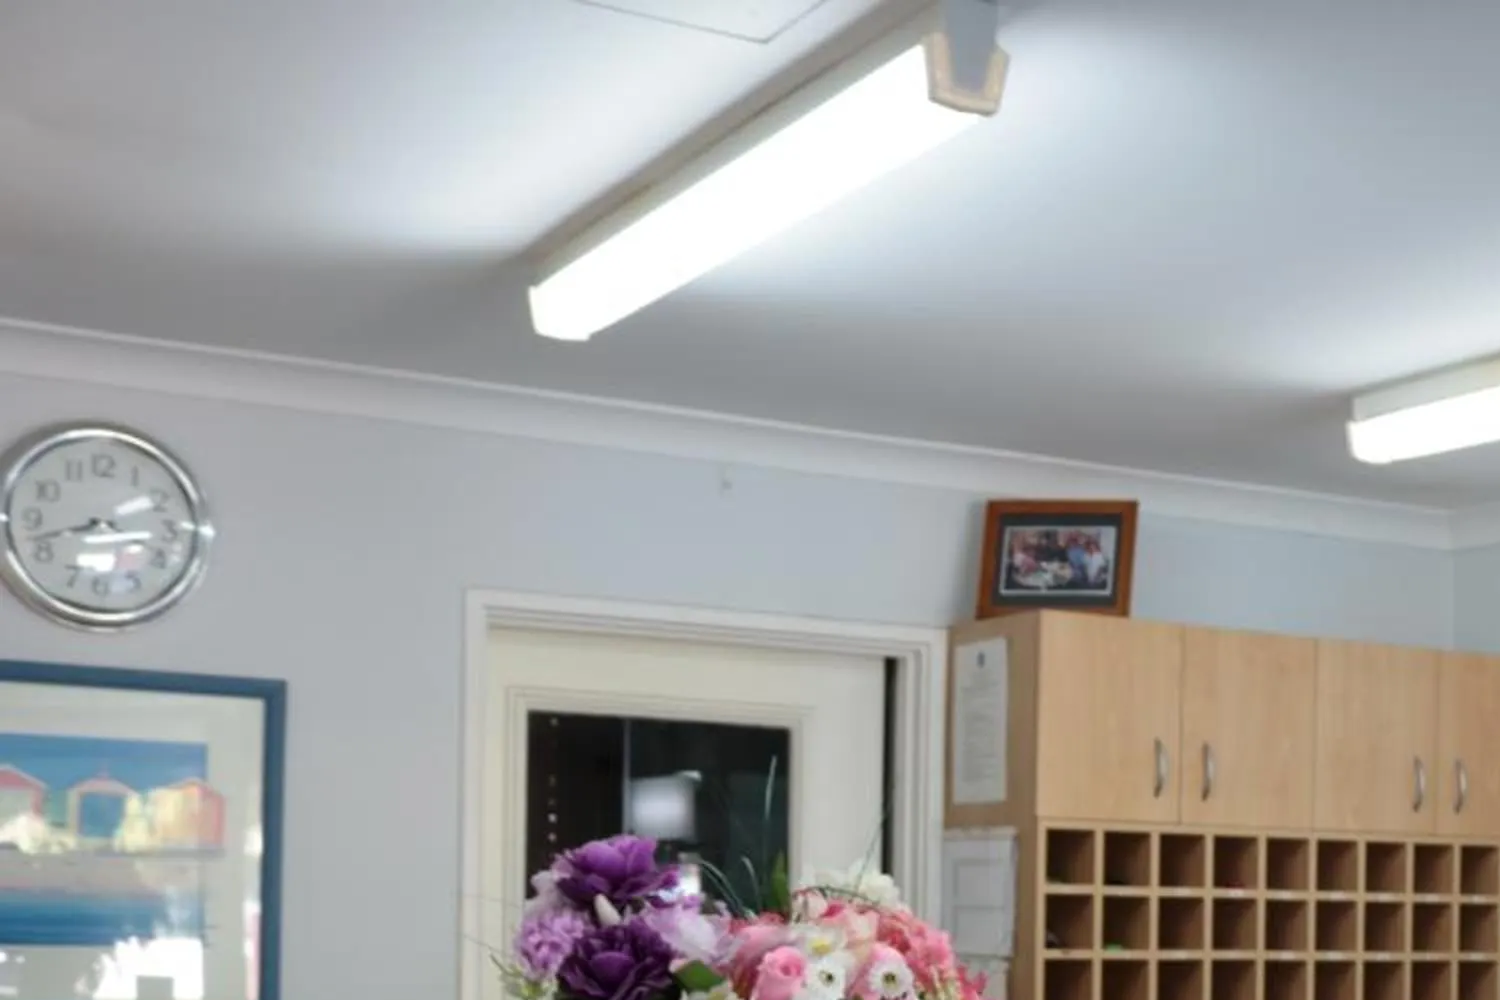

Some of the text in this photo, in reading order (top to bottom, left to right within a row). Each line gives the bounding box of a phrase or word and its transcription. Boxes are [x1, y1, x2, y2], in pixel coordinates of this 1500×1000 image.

[65, 459, 83, 482] 11
[91, 454, 116, 478] 12
[35, 480, 61, 502] 10
[152, 489, 169, 512] 2
[22, 508, 43, 531] 9
[162, 519, 178, 543] 3
[33, 541, 54, 563] 8
[65, 565, 84, 588] 7
[91, 576, 109, 597] 6
